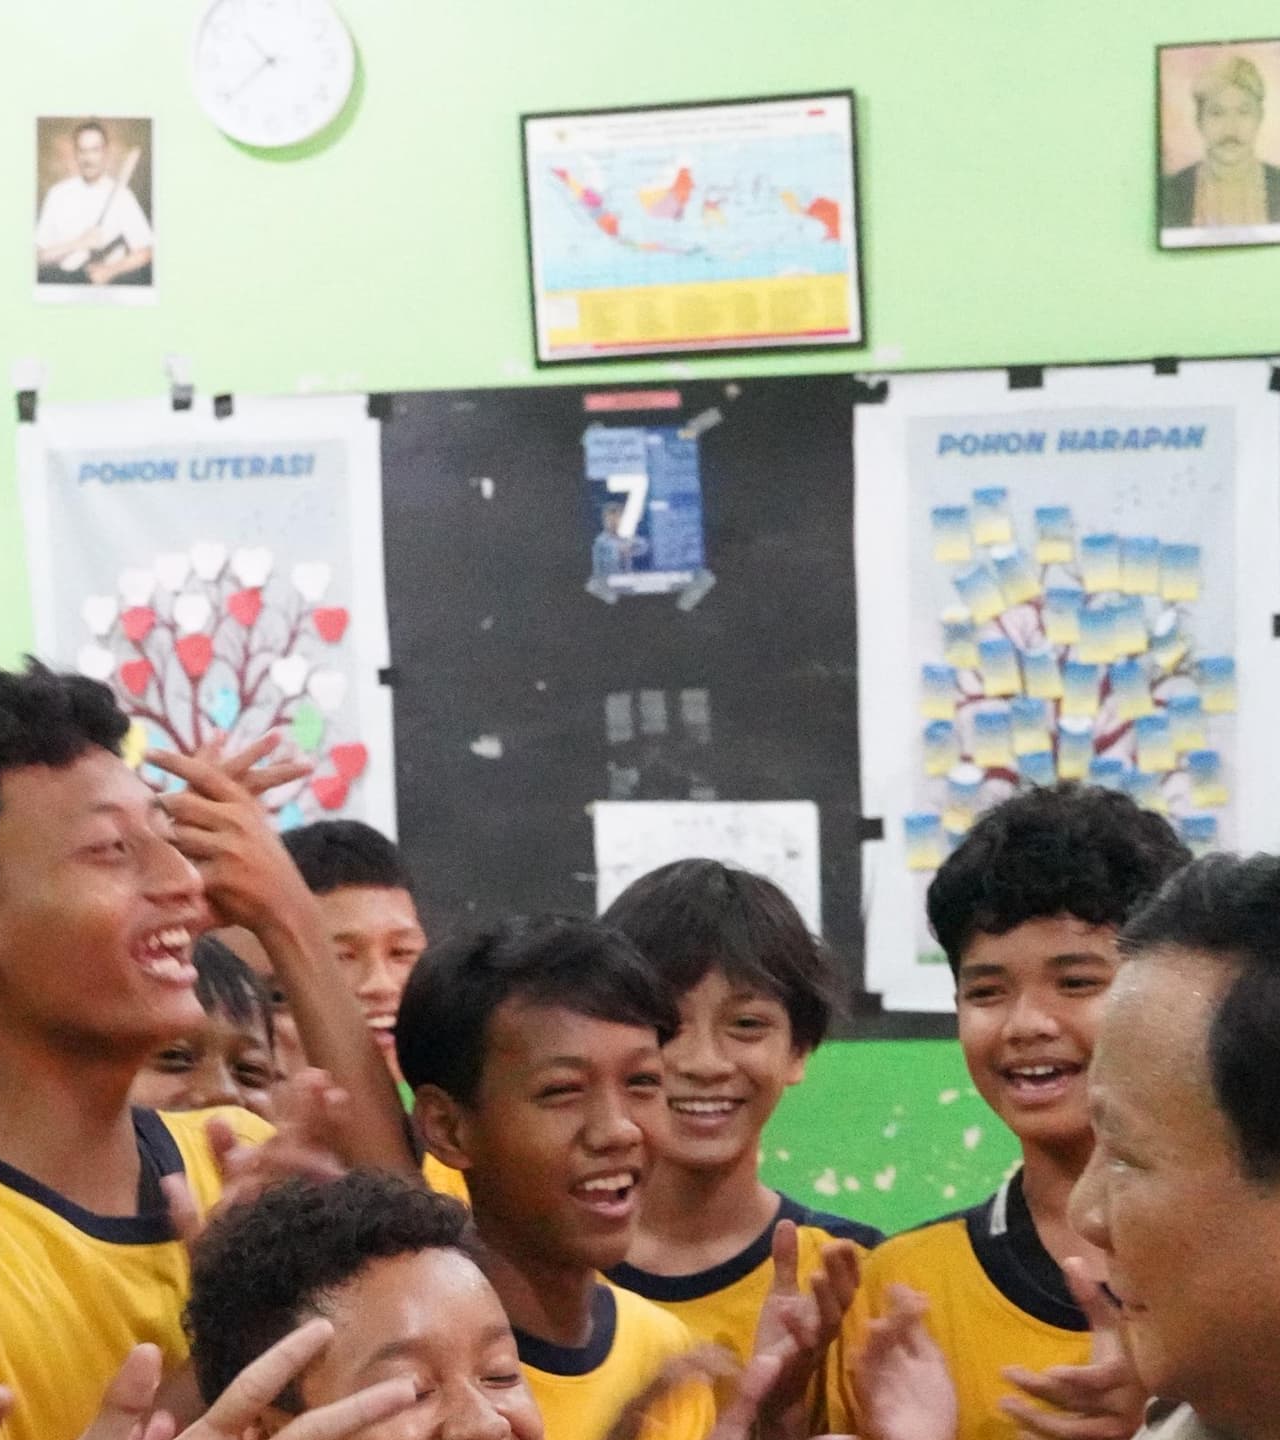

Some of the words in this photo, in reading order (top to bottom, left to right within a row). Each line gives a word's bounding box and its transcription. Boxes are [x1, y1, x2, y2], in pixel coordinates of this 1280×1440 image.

[938, 430, 1047, 456] POHON
[1058, 425, 1206, 453] HARAPAN
[78, 458, 177, 485] POHON
[190, 453, 315, 481] LITERASI
[606, 473, 650, 539] 7
